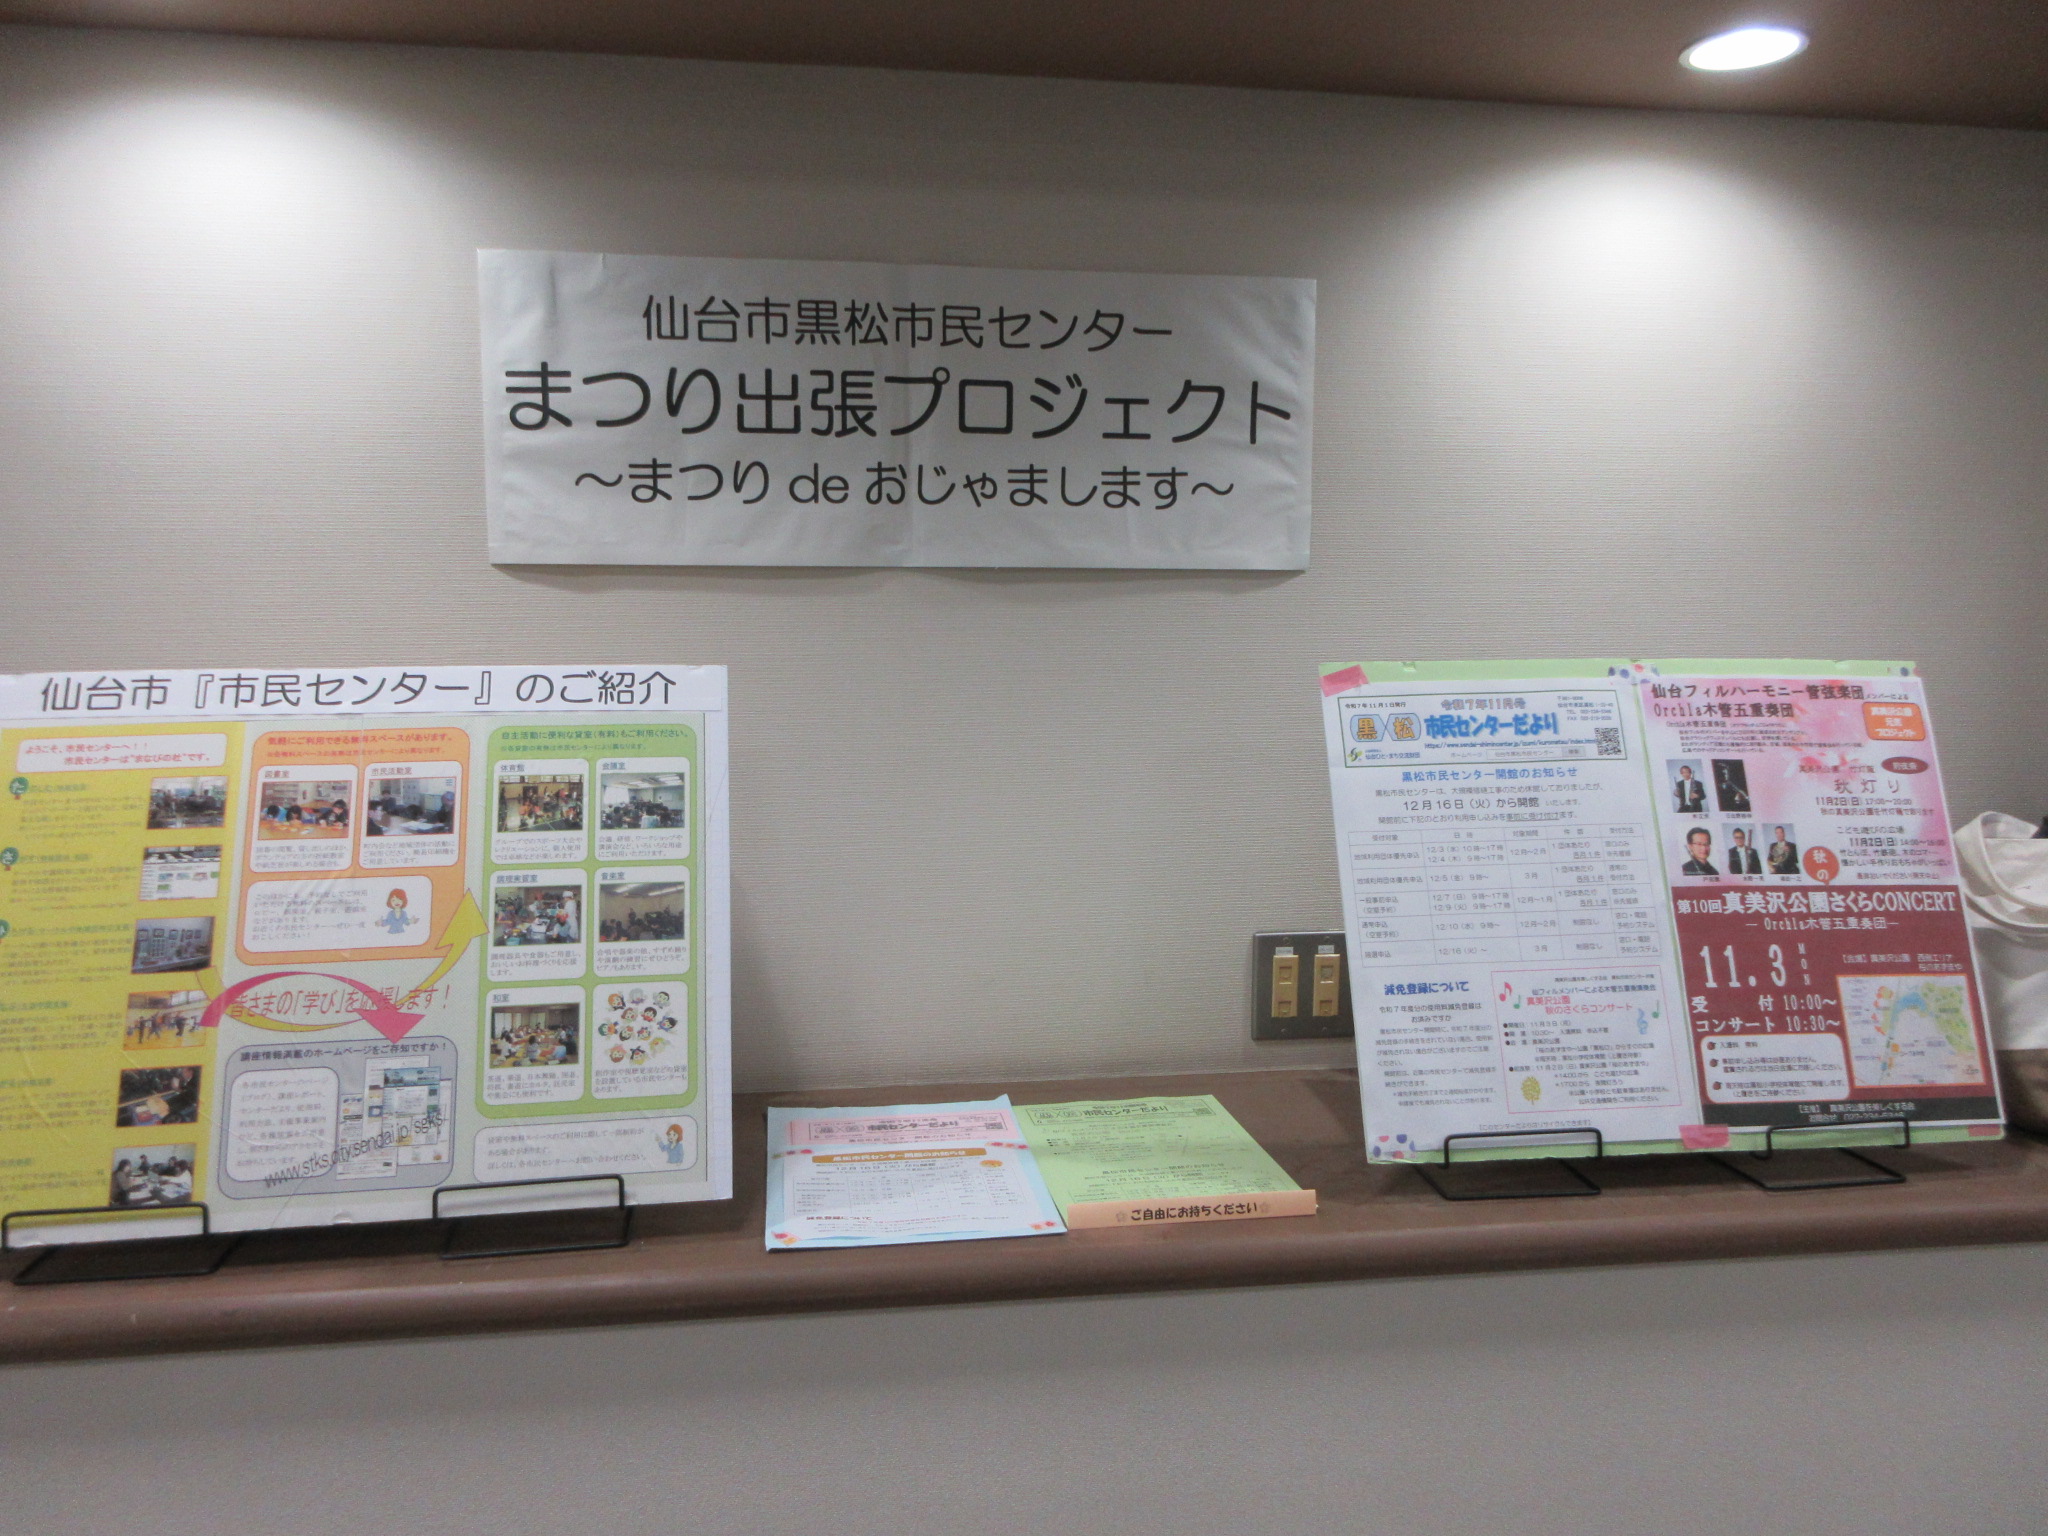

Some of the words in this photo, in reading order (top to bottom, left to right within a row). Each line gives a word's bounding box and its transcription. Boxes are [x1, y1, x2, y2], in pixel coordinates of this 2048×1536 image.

[643, 294, 1172, 352] 仙台市黒松市民センター
[504, 361, 1291, 445] まつり出張プロジェクト
[789, 465, 849, 504] de
[41, 672, 677, 712] 仙台市『市民センター』のご紹介
[1651, 683, 1865, 701] 仙台フィルハーモニー管弦楽団
[1356, 717, 1378, 740] 黒
[1393, 716, 1415, 739] 松
[1424, 712, 1560, 740] 市民センターだより
[1402, 767, 1578, 783] 黒松市民センター開館のお知らせ
[1699, 943, 1787, 988] 11.3
[493, 993, 510, 1003] 和室
[1384, 981, 1470, 996] 減免登録について
[1545, 1002, 1633, 1016] 秋のさくらコンサート
[1695, 1017, 1775, 1034] コンサート
[1130, 1202, 1258, 1221] ご自由にお持ちください
